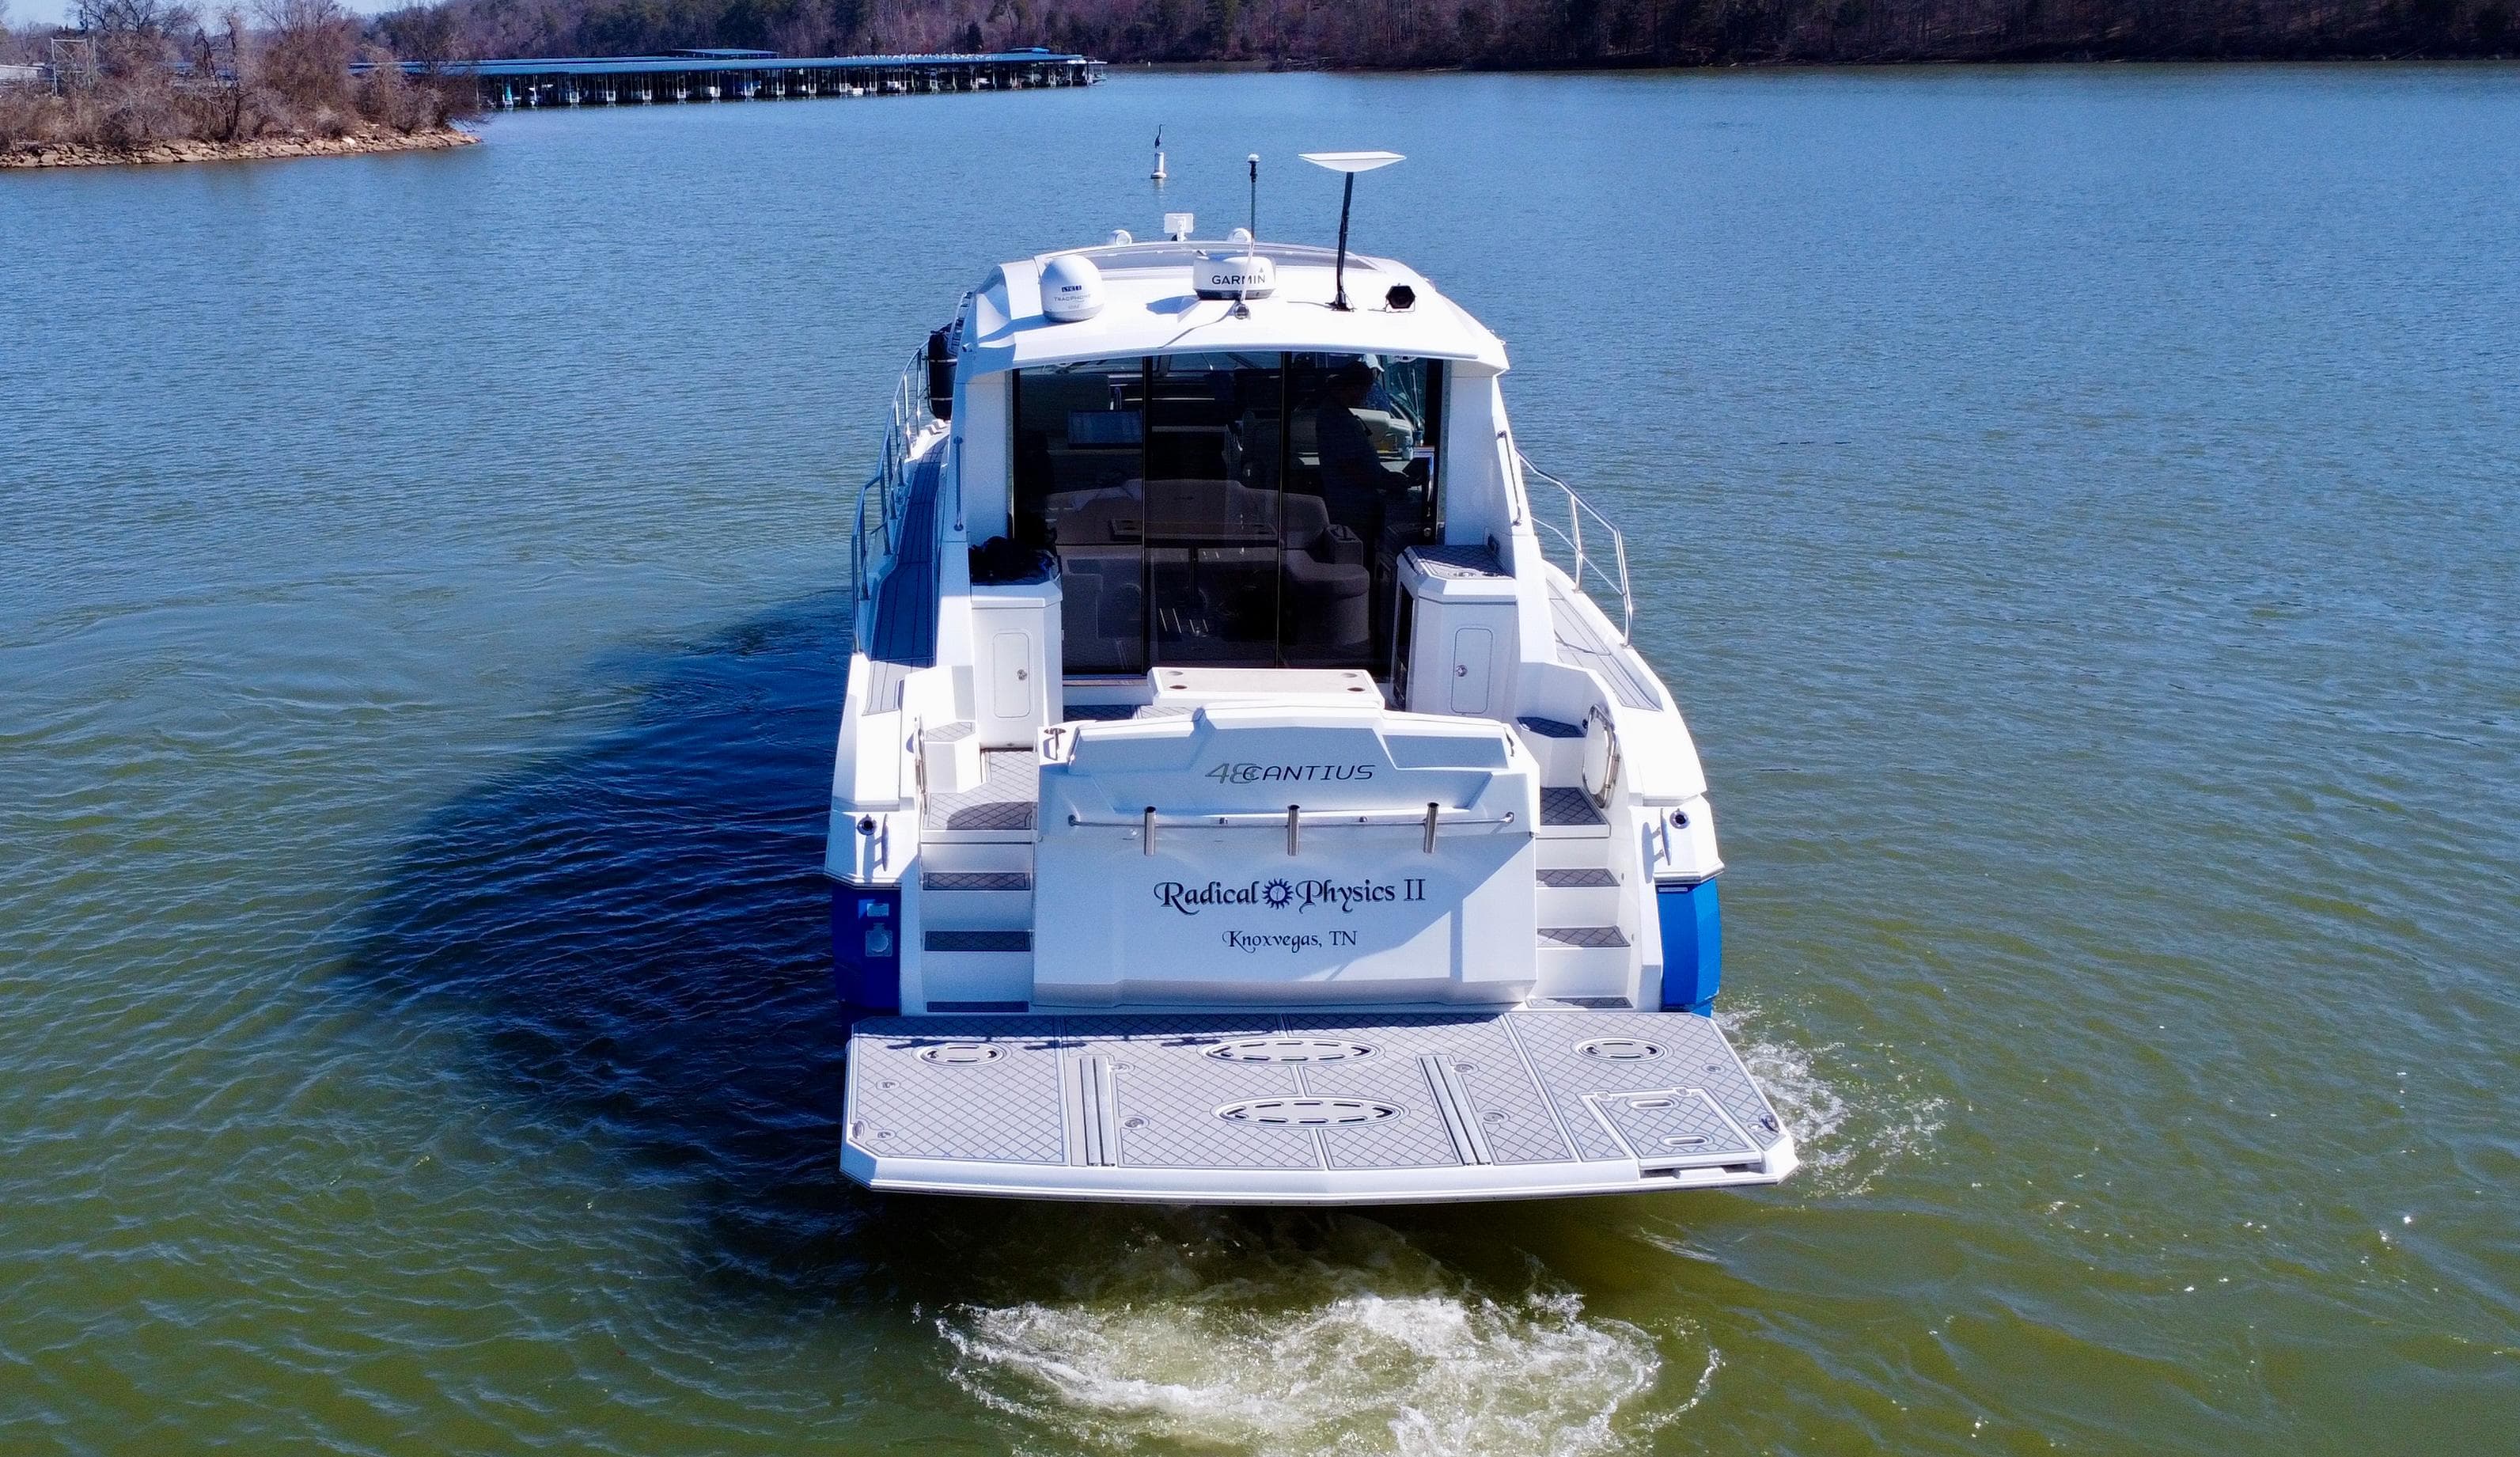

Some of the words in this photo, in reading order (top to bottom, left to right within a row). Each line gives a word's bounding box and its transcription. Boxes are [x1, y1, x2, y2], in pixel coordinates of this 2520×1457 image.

[1211, 274, 1266, 285] GARMIN
[1242, 765, 1376, 781] CANTIUS
[1153, 880, 1260, 916] Radical
[1295, 878, 1396, 914] Physics
[1403, 878, 1427, 901] II
[1222, 930, 1323, 954] Knoxvegas,
[1329, 930, 1359, 947] TN
